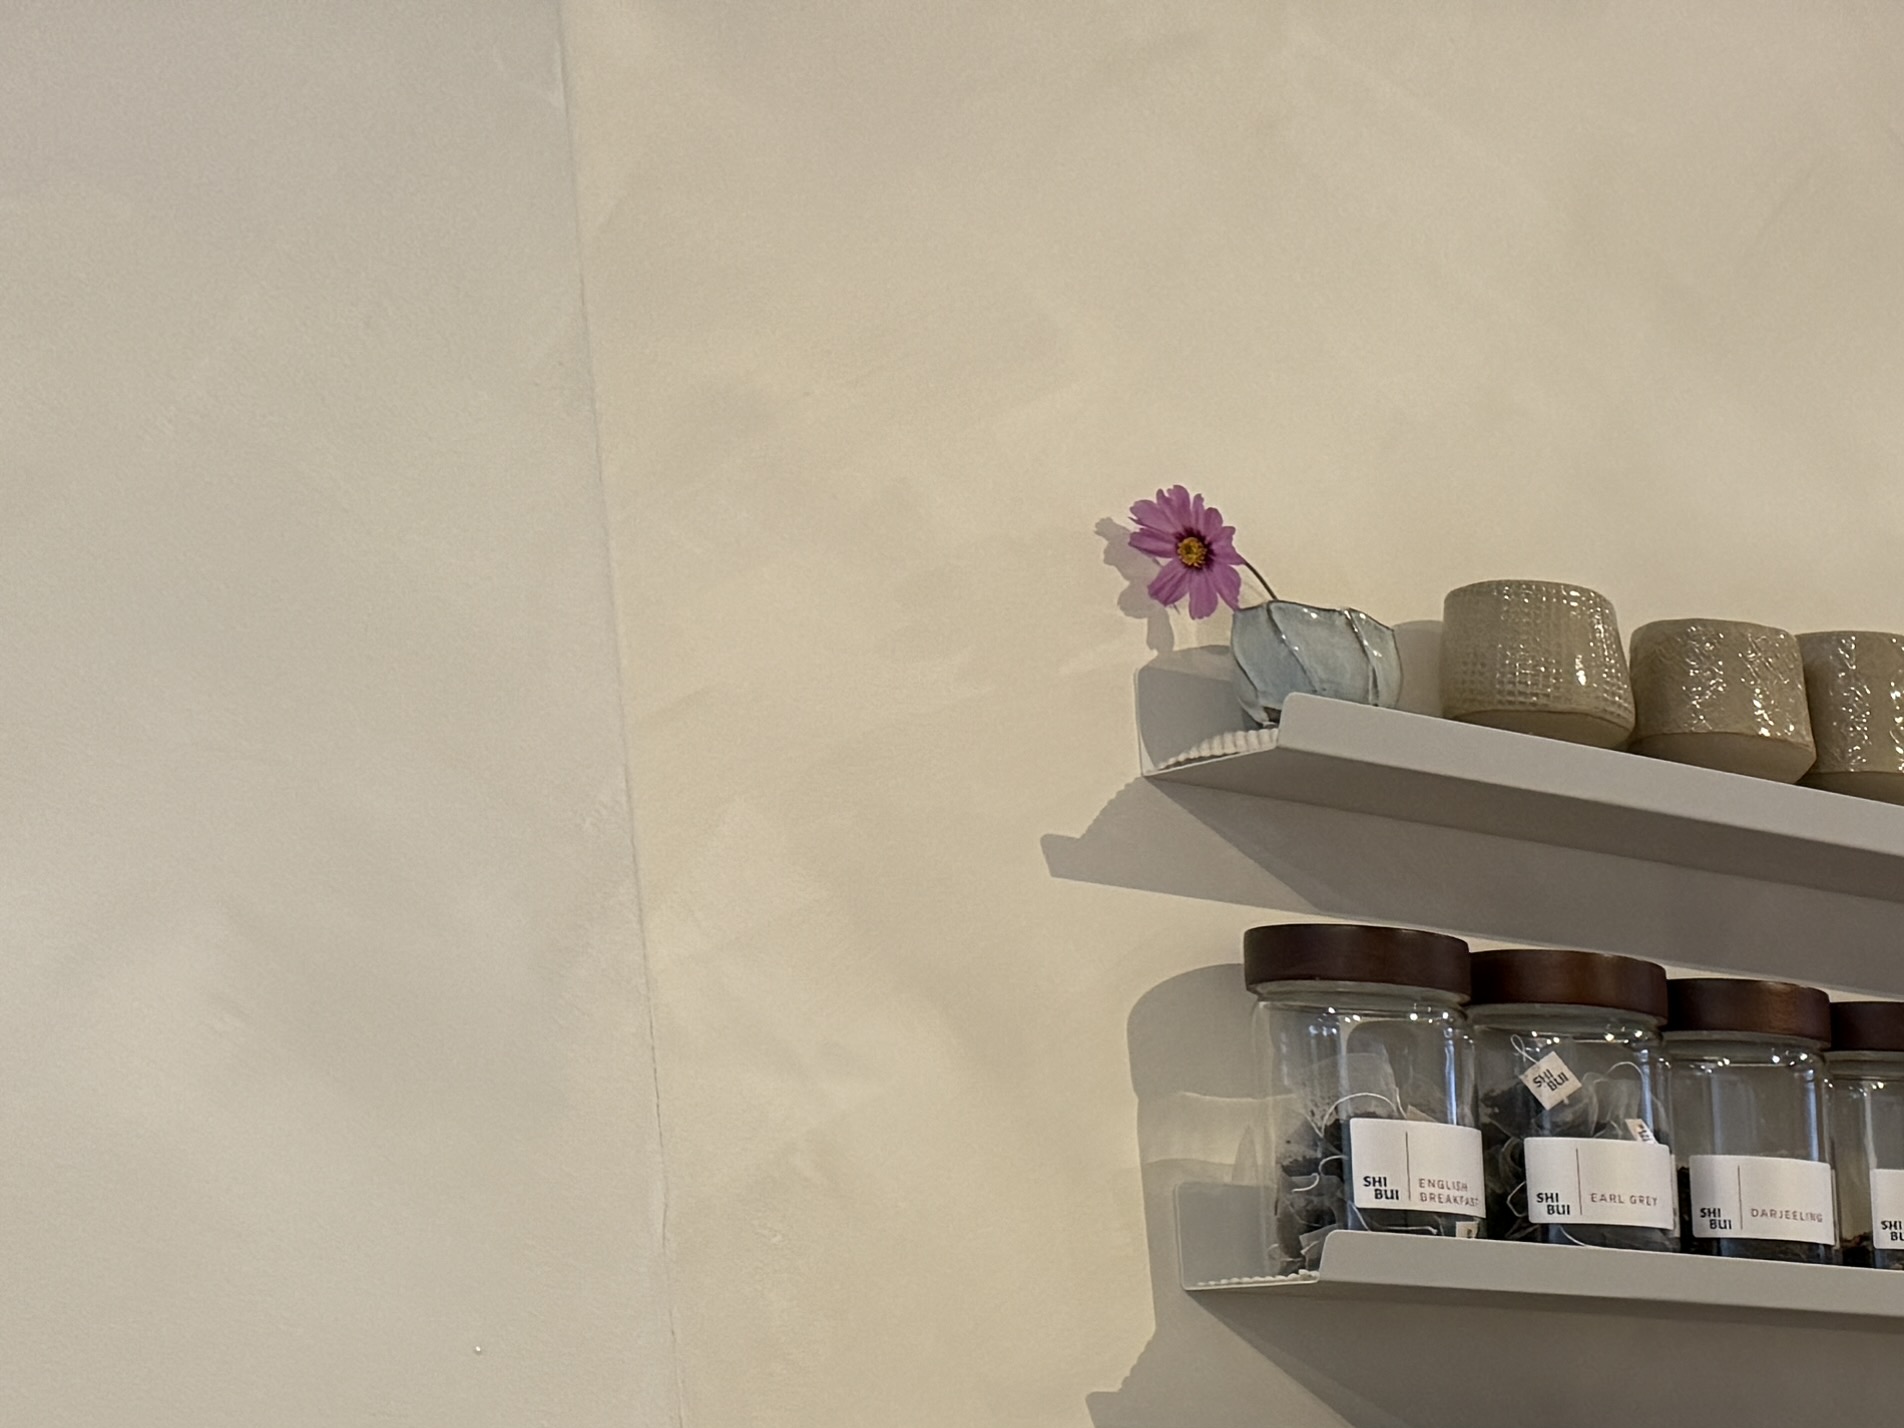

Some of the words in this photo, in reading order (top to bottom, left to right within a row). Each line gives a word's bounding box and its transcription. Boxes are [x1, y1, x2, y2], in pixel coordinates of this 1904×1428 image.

[1362, 1175, 1387, 1187] SHI
[1418, 1178, 1468, 1192] ENGLISH
[1374, 1188, 1399, 1201] BUI
[1419, 1192, 1480, 1207] BREAKFAST
[1536, 1192, 1559, 1203] SHI
[1590, 1192, 1625, 1204] EARL
[1629, 1194, 1658, 1206] GREY
[1546, 1204, 1570, 1215] BUI
[1700, 1207, 1721, 1218] SHI
[1750, 1208, 1823, 1223] DARJEELING
[1709, 1219, 1732, 1230] BUI
[1880, 1220, 1902, 1230] SHI
